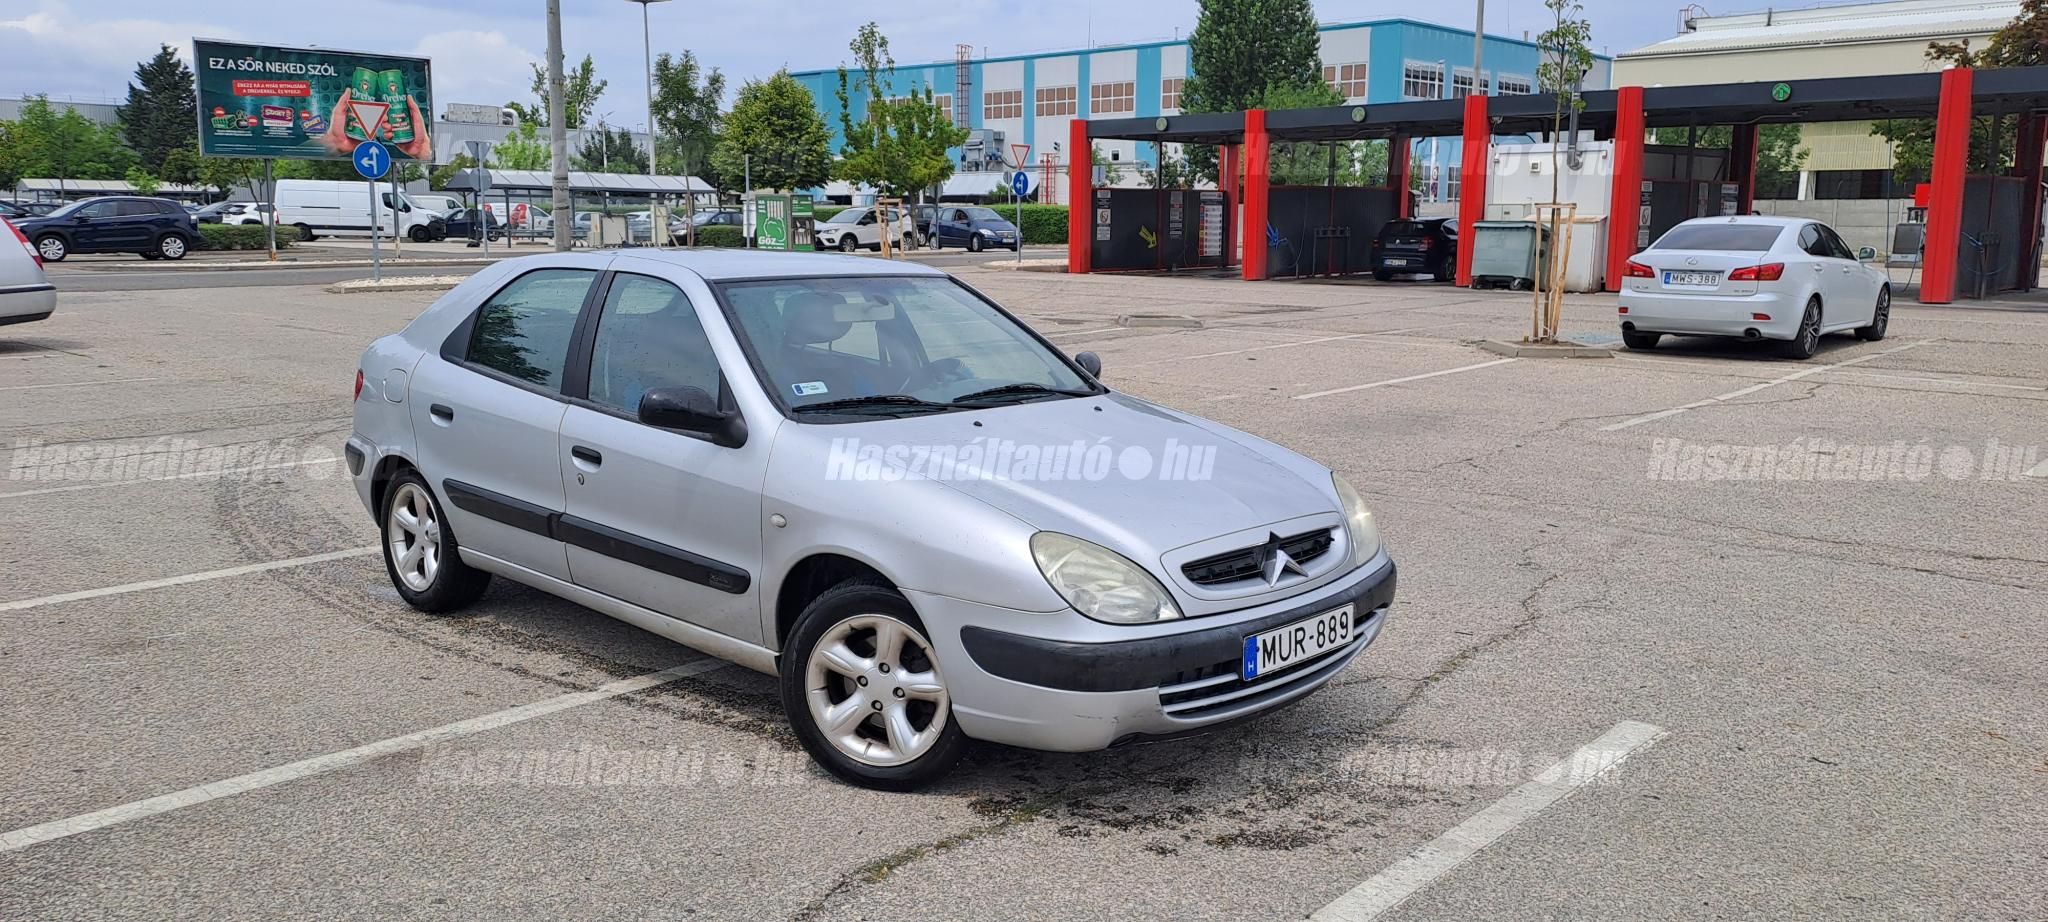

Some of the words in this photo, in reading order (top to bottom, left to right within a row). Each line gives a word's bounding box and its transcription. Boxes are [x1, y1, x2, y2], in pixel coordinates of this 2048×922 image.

[209, 57, 225, 70] EZ
[227, 59, 236, 70] A
[238, 57, 264, 72] SÖR
[266, 62, 306, 75] NEKED
[307, 63, 338, 76] SZÓL
[1671, 272, 1717, 285] MWS-388
[1262, 611, 1349, 669] MUR-889
[1247, 661, 1255, 673] H
